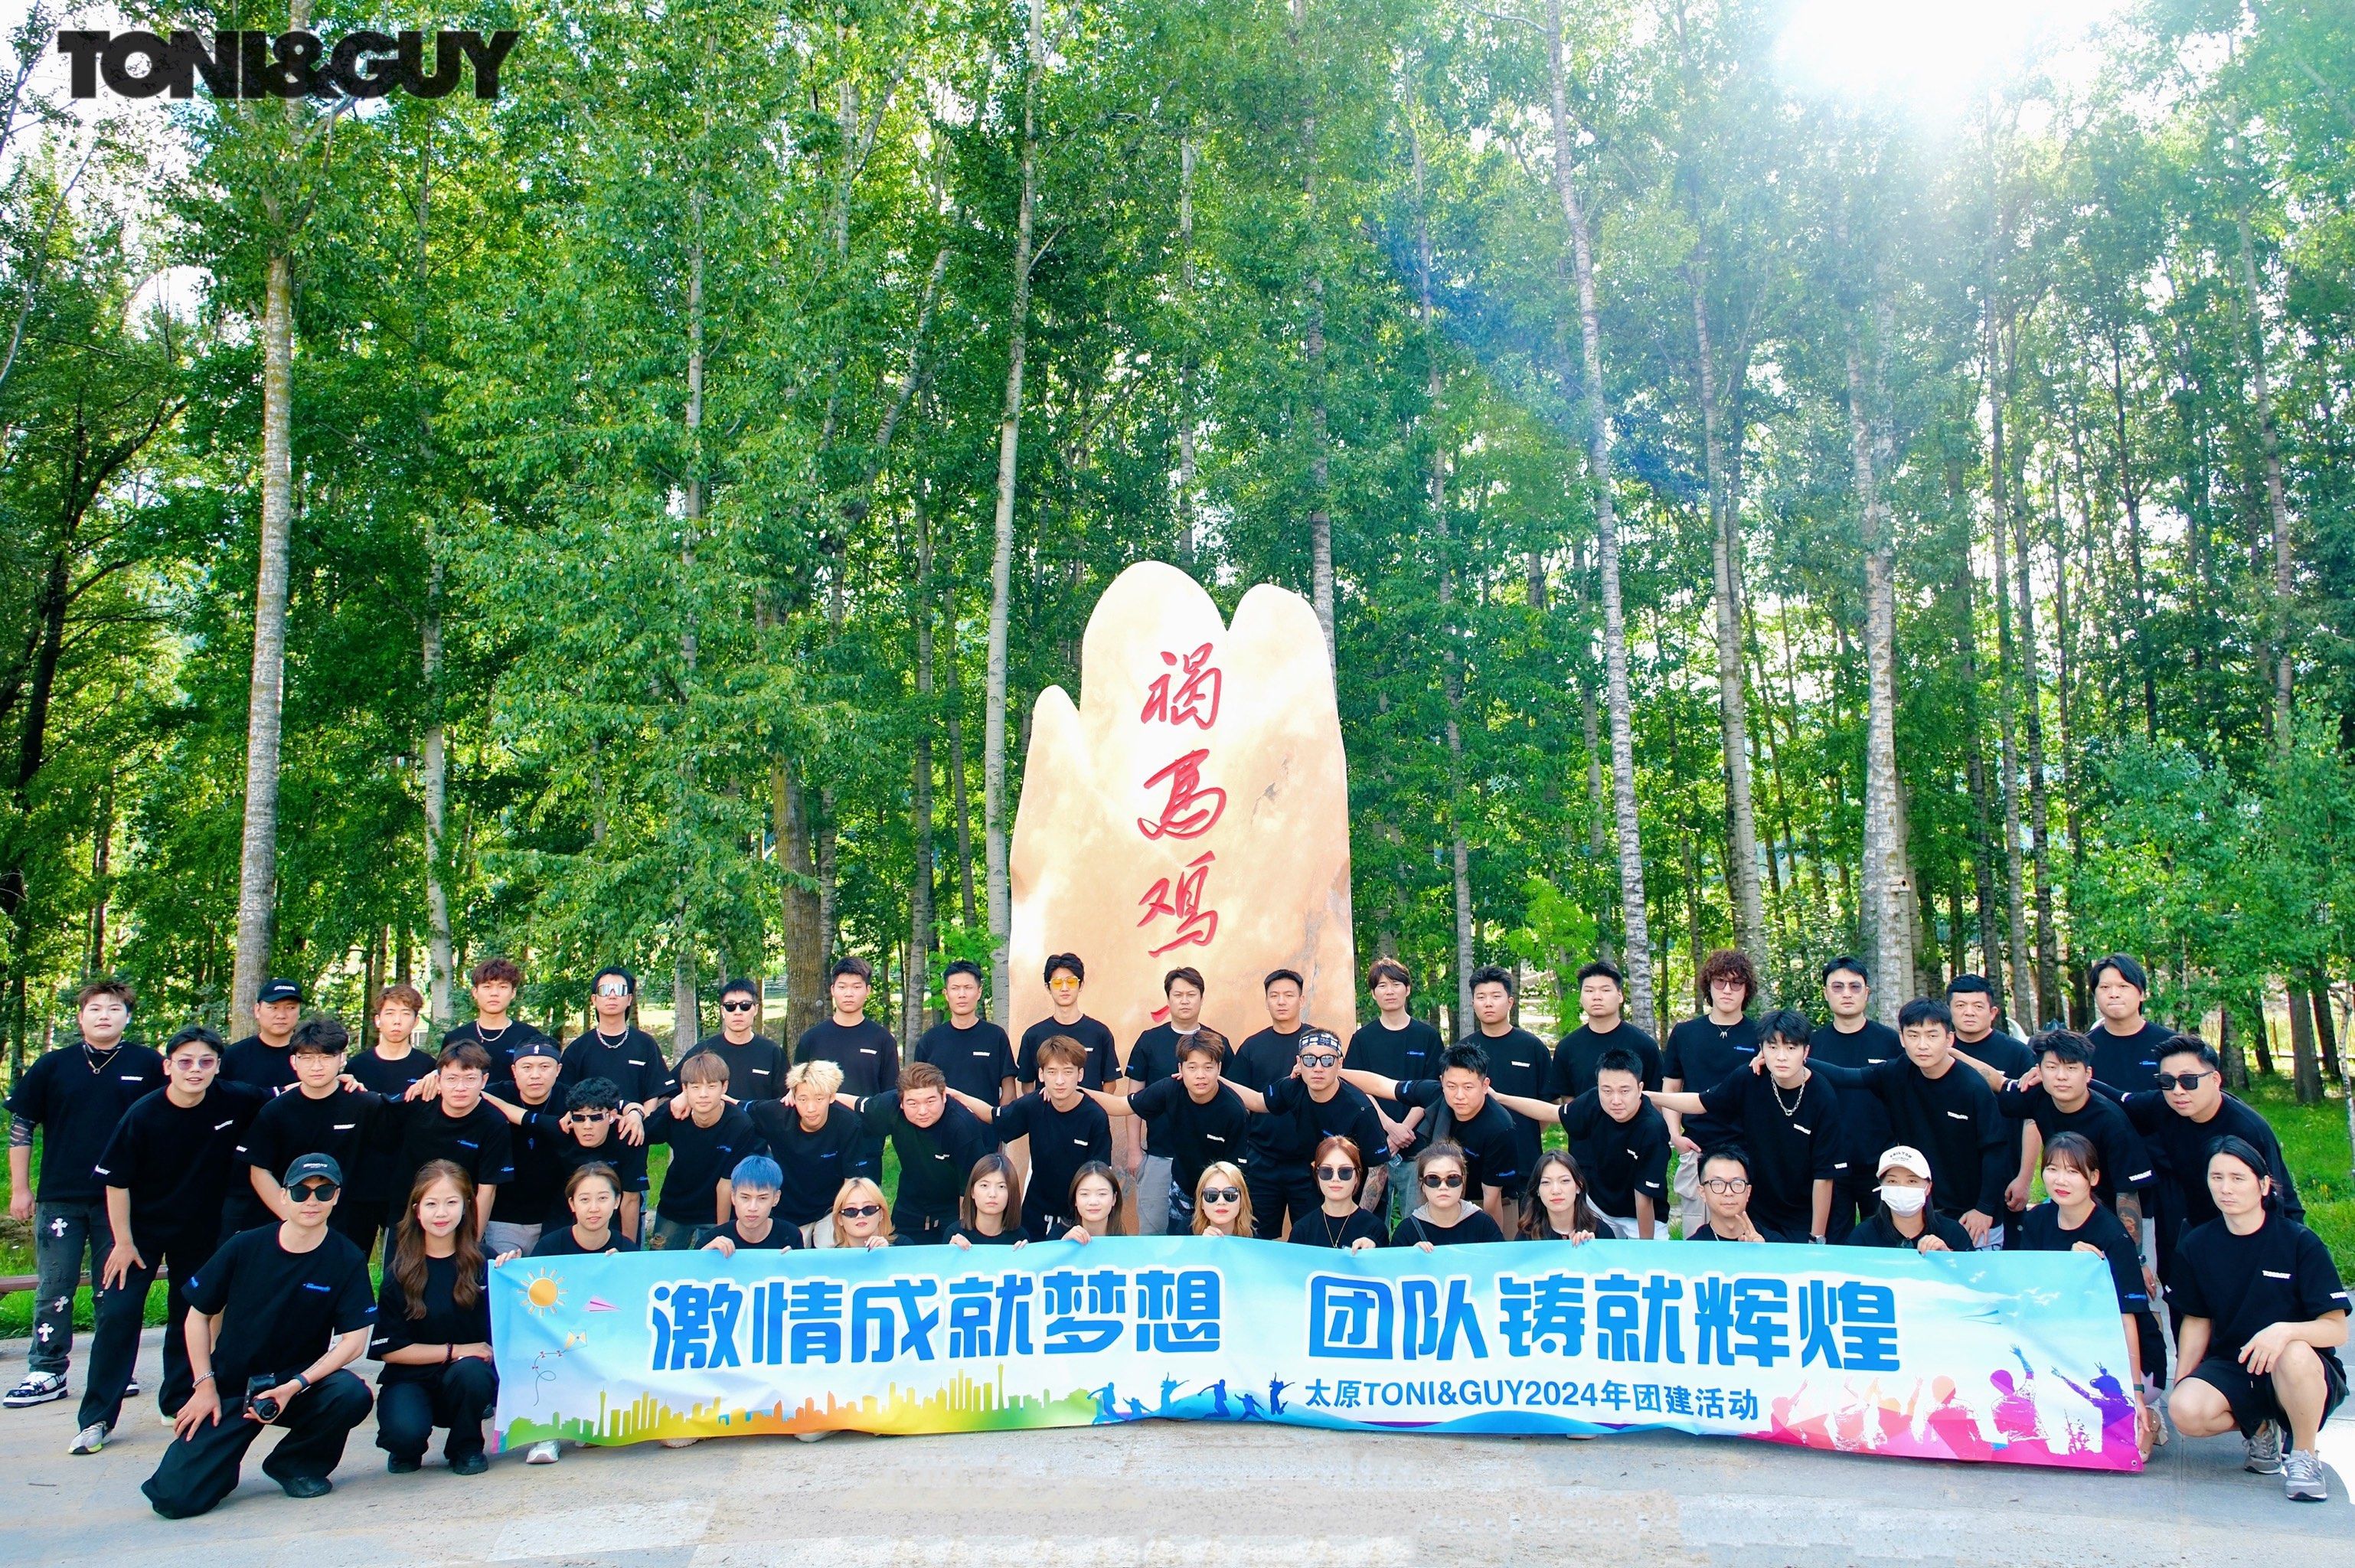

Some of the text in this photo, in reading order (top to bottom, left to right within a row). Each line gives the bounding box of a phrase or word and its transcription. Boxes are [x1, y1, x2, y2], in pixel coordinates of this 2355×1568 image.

[652, 1270, 1220, 1370] 激情成就梦想
[1308, 1273, 1900, 1371] 团队铸就辉煌
[1305, 1378, 1759, 1420] 太原TONI&GUY2024年团建活动
